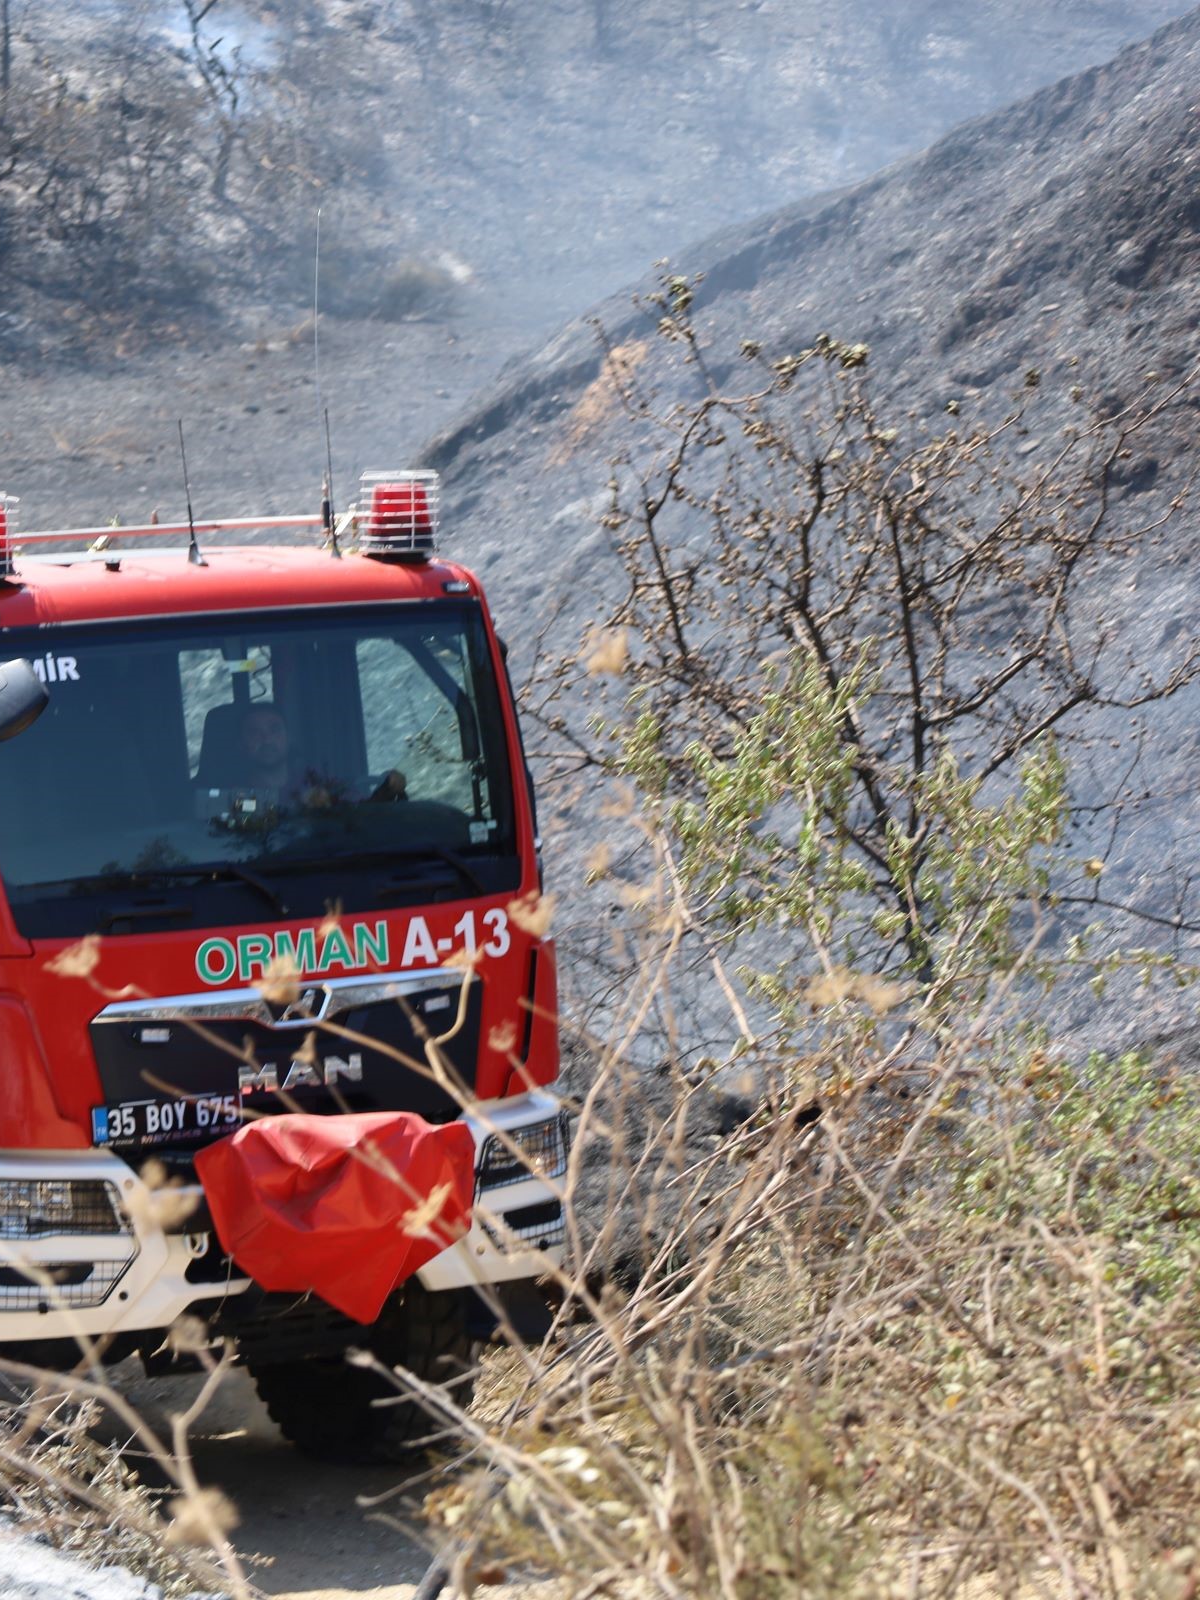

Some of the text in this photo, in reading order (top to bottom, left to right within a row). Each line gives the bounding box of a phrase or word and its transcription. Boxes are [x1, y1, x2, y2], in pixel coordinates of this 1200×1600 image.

[195, 908, 511, 985] ORMAN A-13
[238, 1053, 363, 1094] MAN
[107, 1107, 136, 1138] 35
[145, 1101, 186, 1133] BOY
[196, 1095, 238, 1127] 675
